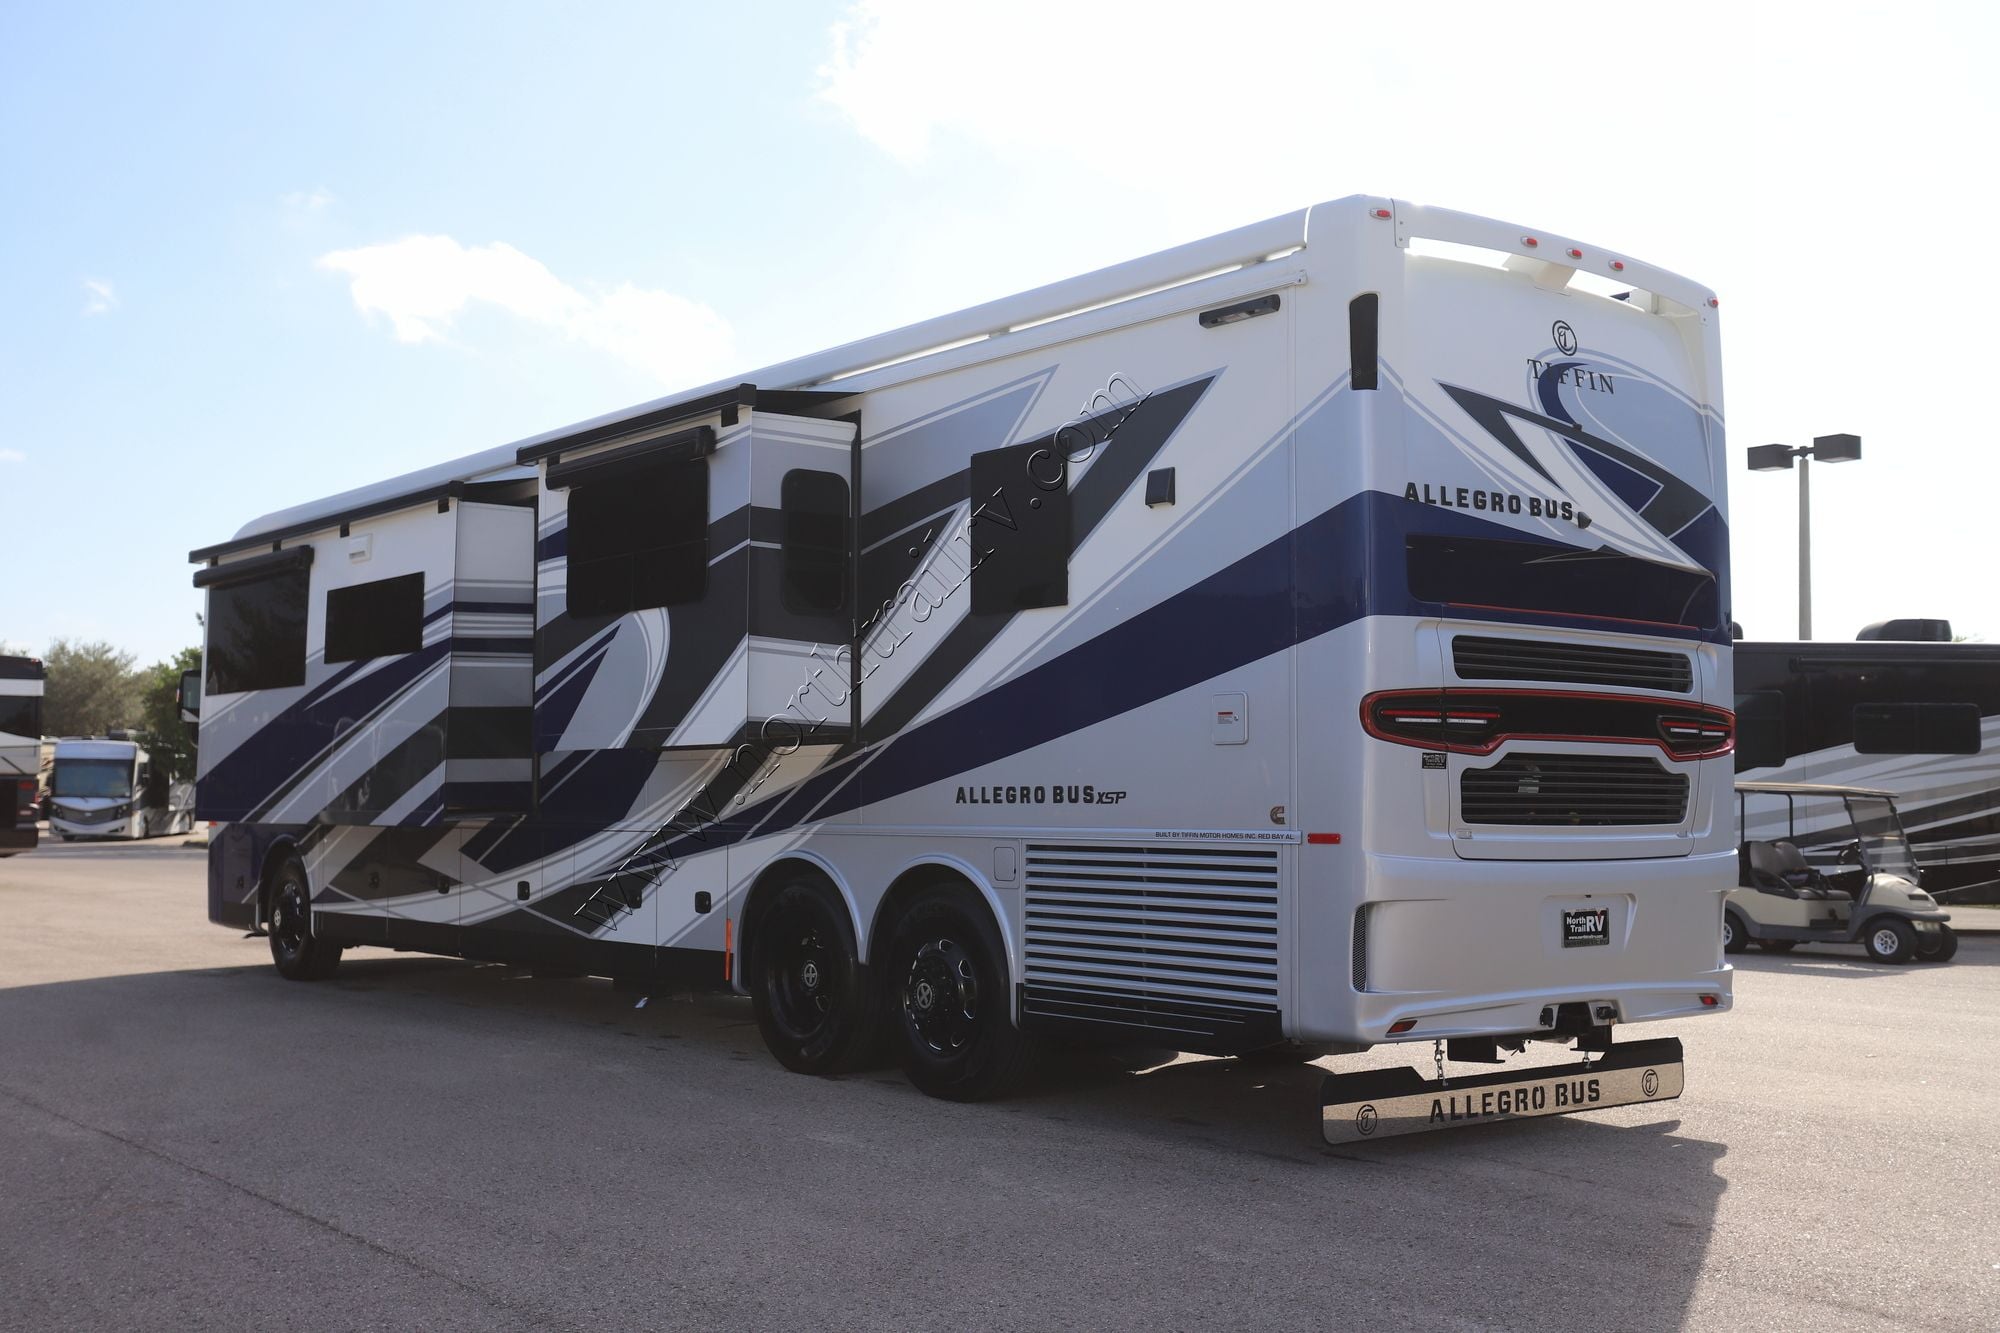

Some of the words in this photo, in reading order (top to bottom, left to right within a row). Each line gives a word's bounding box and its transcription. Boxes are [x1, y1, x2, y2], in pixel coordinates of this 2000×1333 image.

[1527, 358, 1614, 395] TFFIN
[1404, 481, 1522, 515] ALLEGRO
[1529, 497, 1573, 521] BUS
[955, 786, 1046, 805] ALLEGRO
[1052, 785, 1095, 804] BUS
[1095, 791, 1127, 805] XSP
[1566, 916, 1586, 925] North
[1586, 915, 1604, 931] RV
[1570, 924, 1586, 933] Trail
[1429, 1086, 1546, 1123] ALLEGRO
[1554, 1079, 1600, 1107] BUS
